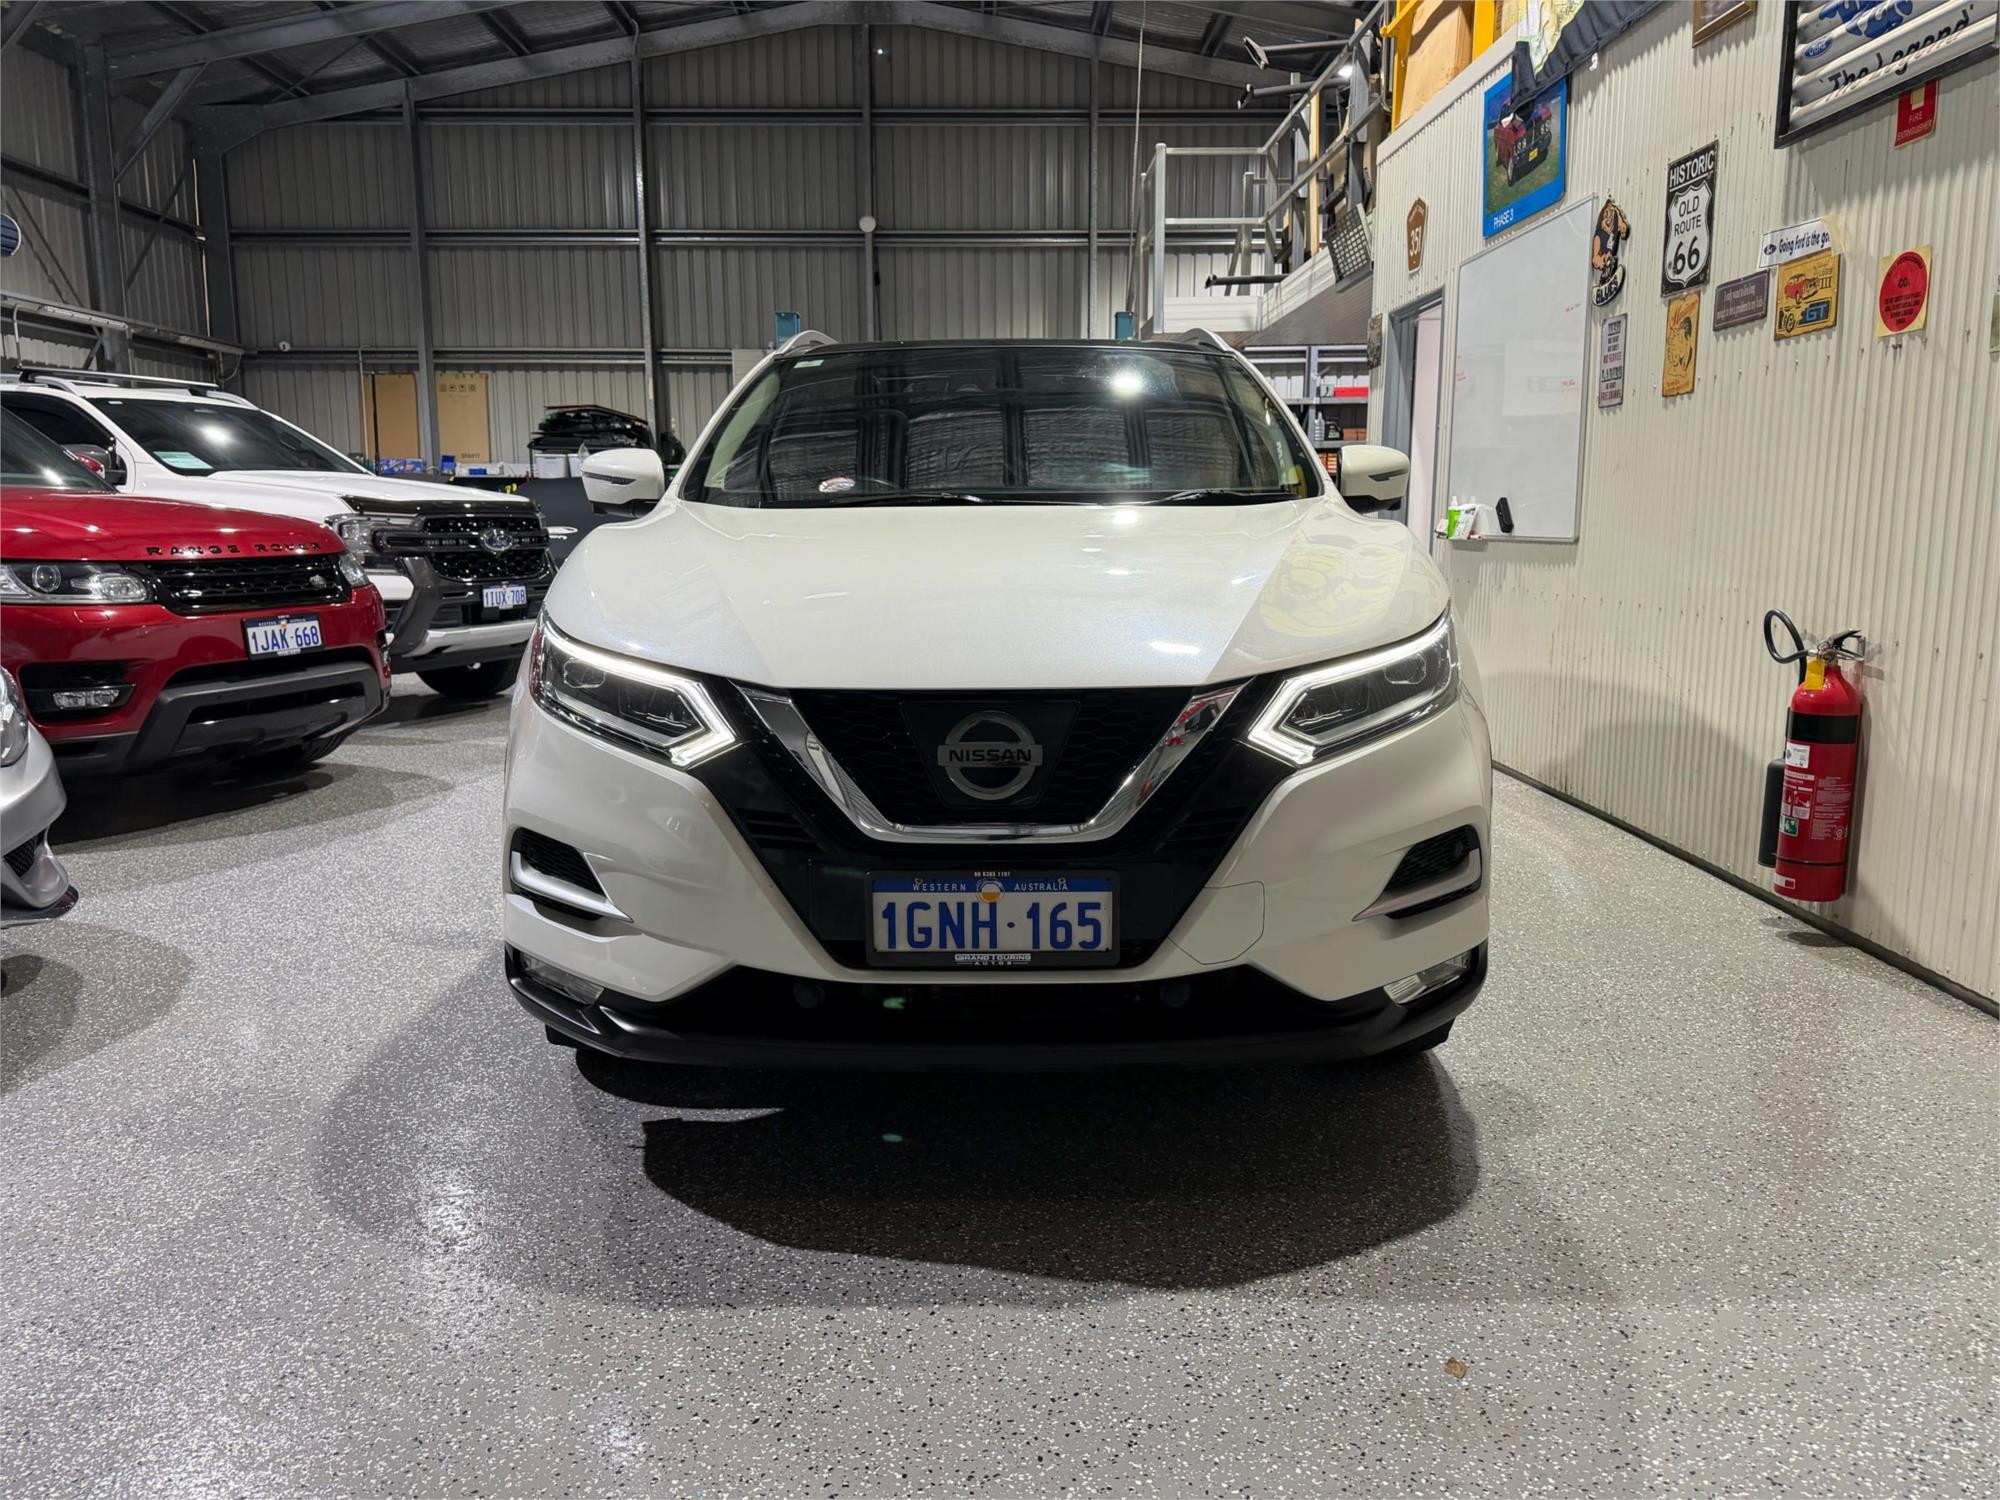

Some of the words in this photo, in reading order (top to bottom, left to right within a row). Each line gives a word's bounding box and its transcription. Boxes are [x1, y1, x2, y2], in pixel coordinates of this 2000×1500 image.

[1909, 111, 1923, 123] FIRE
[1897, 120, 1933, 140] EXTINGUISHER
[1669, 150, 1714, 188] HISTORIC
[1678, 195, 1700, 217] OLD
[1493, 211, 1509, 229] PHASE
[1674, 214, 1702, 237] ROUTE
[1409, 225, 1422, 257] 351
[1778, 237, 1794, 255] Going
[1794, 233, 1805, 250] Ford
[1811, 230, 1820, 246] the
[1673, 235, 1700, 275] 66
[1806, 303, 1827, 321] GT
[146, 545, 241, 556] RANGE
[255, 542, 321, 553] ROVER
[950, 749, 1031, 762] NISSAN
[912, 882, 967, 892] WESTERN
[1014, 882, 1069, 892] AUSTRALIA
[955, 953, 990, 961] GRAND
[990, 953, 1031, 961] TOURING
